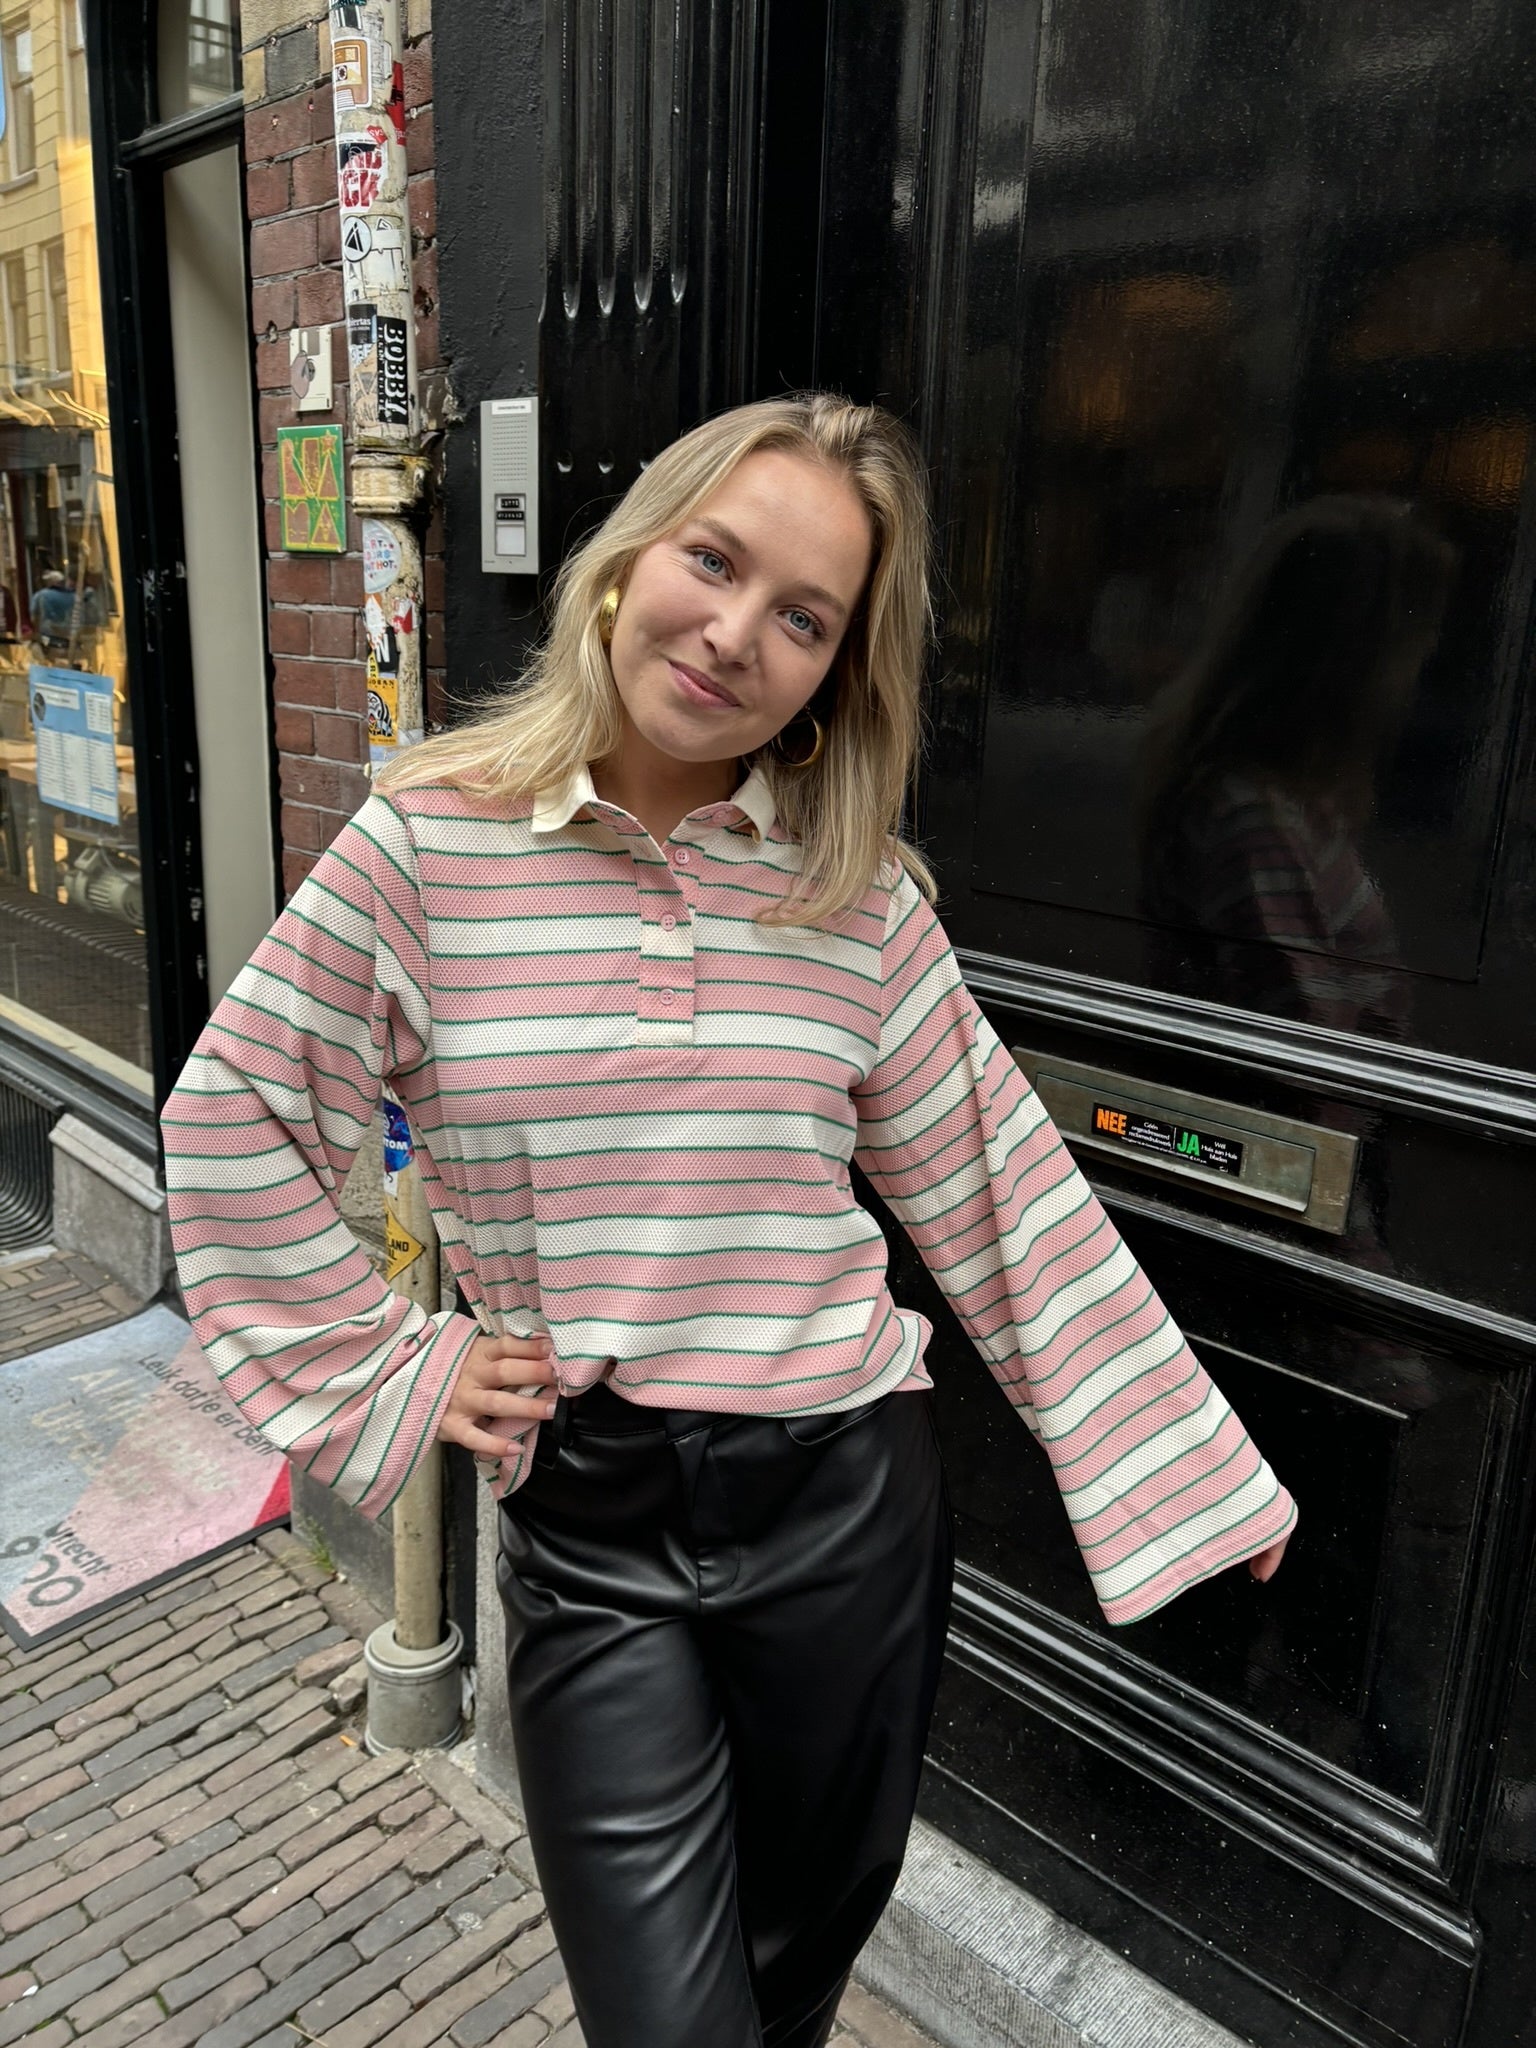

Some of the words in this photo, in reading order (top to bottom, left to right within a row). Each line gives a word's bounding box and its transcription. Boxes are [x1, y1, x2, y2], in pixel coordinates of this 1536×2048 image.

[383, 323, 408, 416] BOBBY
[1096, 1108, 1128, 1136] NEE
[1128, 1131, 1172, 1147] reclamedrukwerk
[1176, 1131, 1200, 1157] JA
[1201, 1144, 1214, 1153] Huis
[1214, 1148, 1225, 1156] aan
[1224, 1151, 1238, 1160] Huis
[1209, 1153, 1228, 1164] bladen
[137, 1352, 184, 1383] Leuk
[170, 1379, 208, 1403] dat
[187, 1393, 221, 1414] je
[214, 1411, 242, 1428] er
